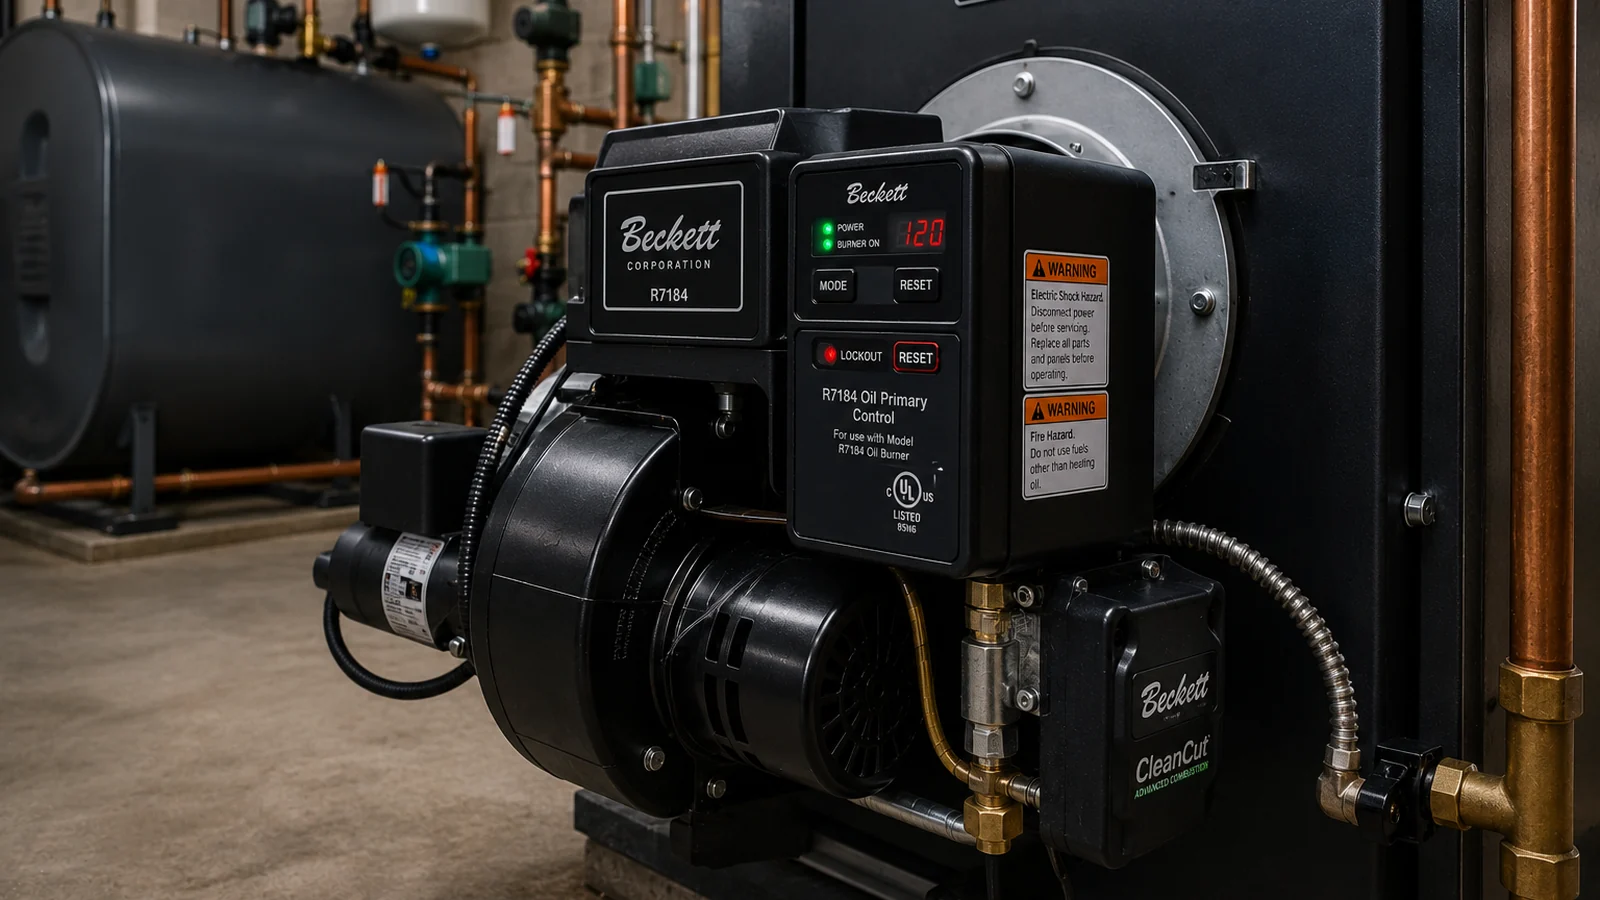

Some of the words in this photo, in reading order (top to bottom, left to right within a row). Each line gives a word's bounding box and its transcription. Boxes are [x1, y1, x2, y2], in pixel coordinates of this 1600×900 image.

[846, 182, 909, 205] Beckett
[620, 214, 721, 253] Beckett
[837, 223, 864, 232] POWER
[905, 218, 944, 247] 120
[837, 240, 867, 249] BURNER
[868, 239, 880, 247] ON
[627, 259, 711, 271] CORPORATION
[1048, 261, 1097, 278] WARNING
[819, 280, 848, 291] MODE
[900, 279, 933, 291] RESET
[650, 288, 689, 302] R7184
[1031, 289, 1058, 301] Electric
[1059, 290, 1079, 302] Shock
[1031, 305, 1072, 318] Disconnect
[1073, 308, 1095, 320] power
[1031, 322, 1055, 333] before
[1057, 322, 1090, 335] servicing.
[1031, 337, 1060, 350] Replace
[1062, 338, 1071, 348] all
[1072, 338, 1091, 350] parts
[840, 350, 882, 362] LOCKOUT
[899, 351, 933, 364] RESET
[1031, 353, 1045, 365] and
[1047, 353, 1070, 365] panels
[1072, 353, 1094, 363] before
[1031, 369, 1068, 382] operating.
[822, 388, 857, 403] R7184
[860, 390, 877, 404] Oil
[880, 391, 928, 411] Primary
[1047, 400, 1096, 417] WARNING
[852, 408, 895, 424] Control
[833, 429, 847, 439] For
[849, 432, 865, 441] use
[866, 432, 884, 444] with
[887, 434, 914, 446] Model
[1030, 431, 1045, 442] Fire
[1047, 429, 1075, 441] Hazard.
[838, 444, 864, 455] R7184
[866, 446, 878, 457] Oil
[880, 448, 910, 461] Burner
[1030, 448, 1041, 459] Do
[1043, 447, 1055, 458] not
[1057, 446, 1070, 456] use
[1072, 443, 1089, 454] fuels
[1030, 463, 1050, 474] other
[1051, 461, 1067, 472] than
[1069, 458, 1095, 470] heating
[900, 478, 915, 501] UL
[923, 492, 934, 503] US
[1030, 479, 1041, 490] oil.
[893, 509, 921, 523] LISTED
[1141, 671, 1209, 719] Beckett
[1135, 735, 1209, 783] CleanCut
[1134, 777, 1169, 800] ADVANCED
[1170, 761, 1210, 785] COMBUSTION
